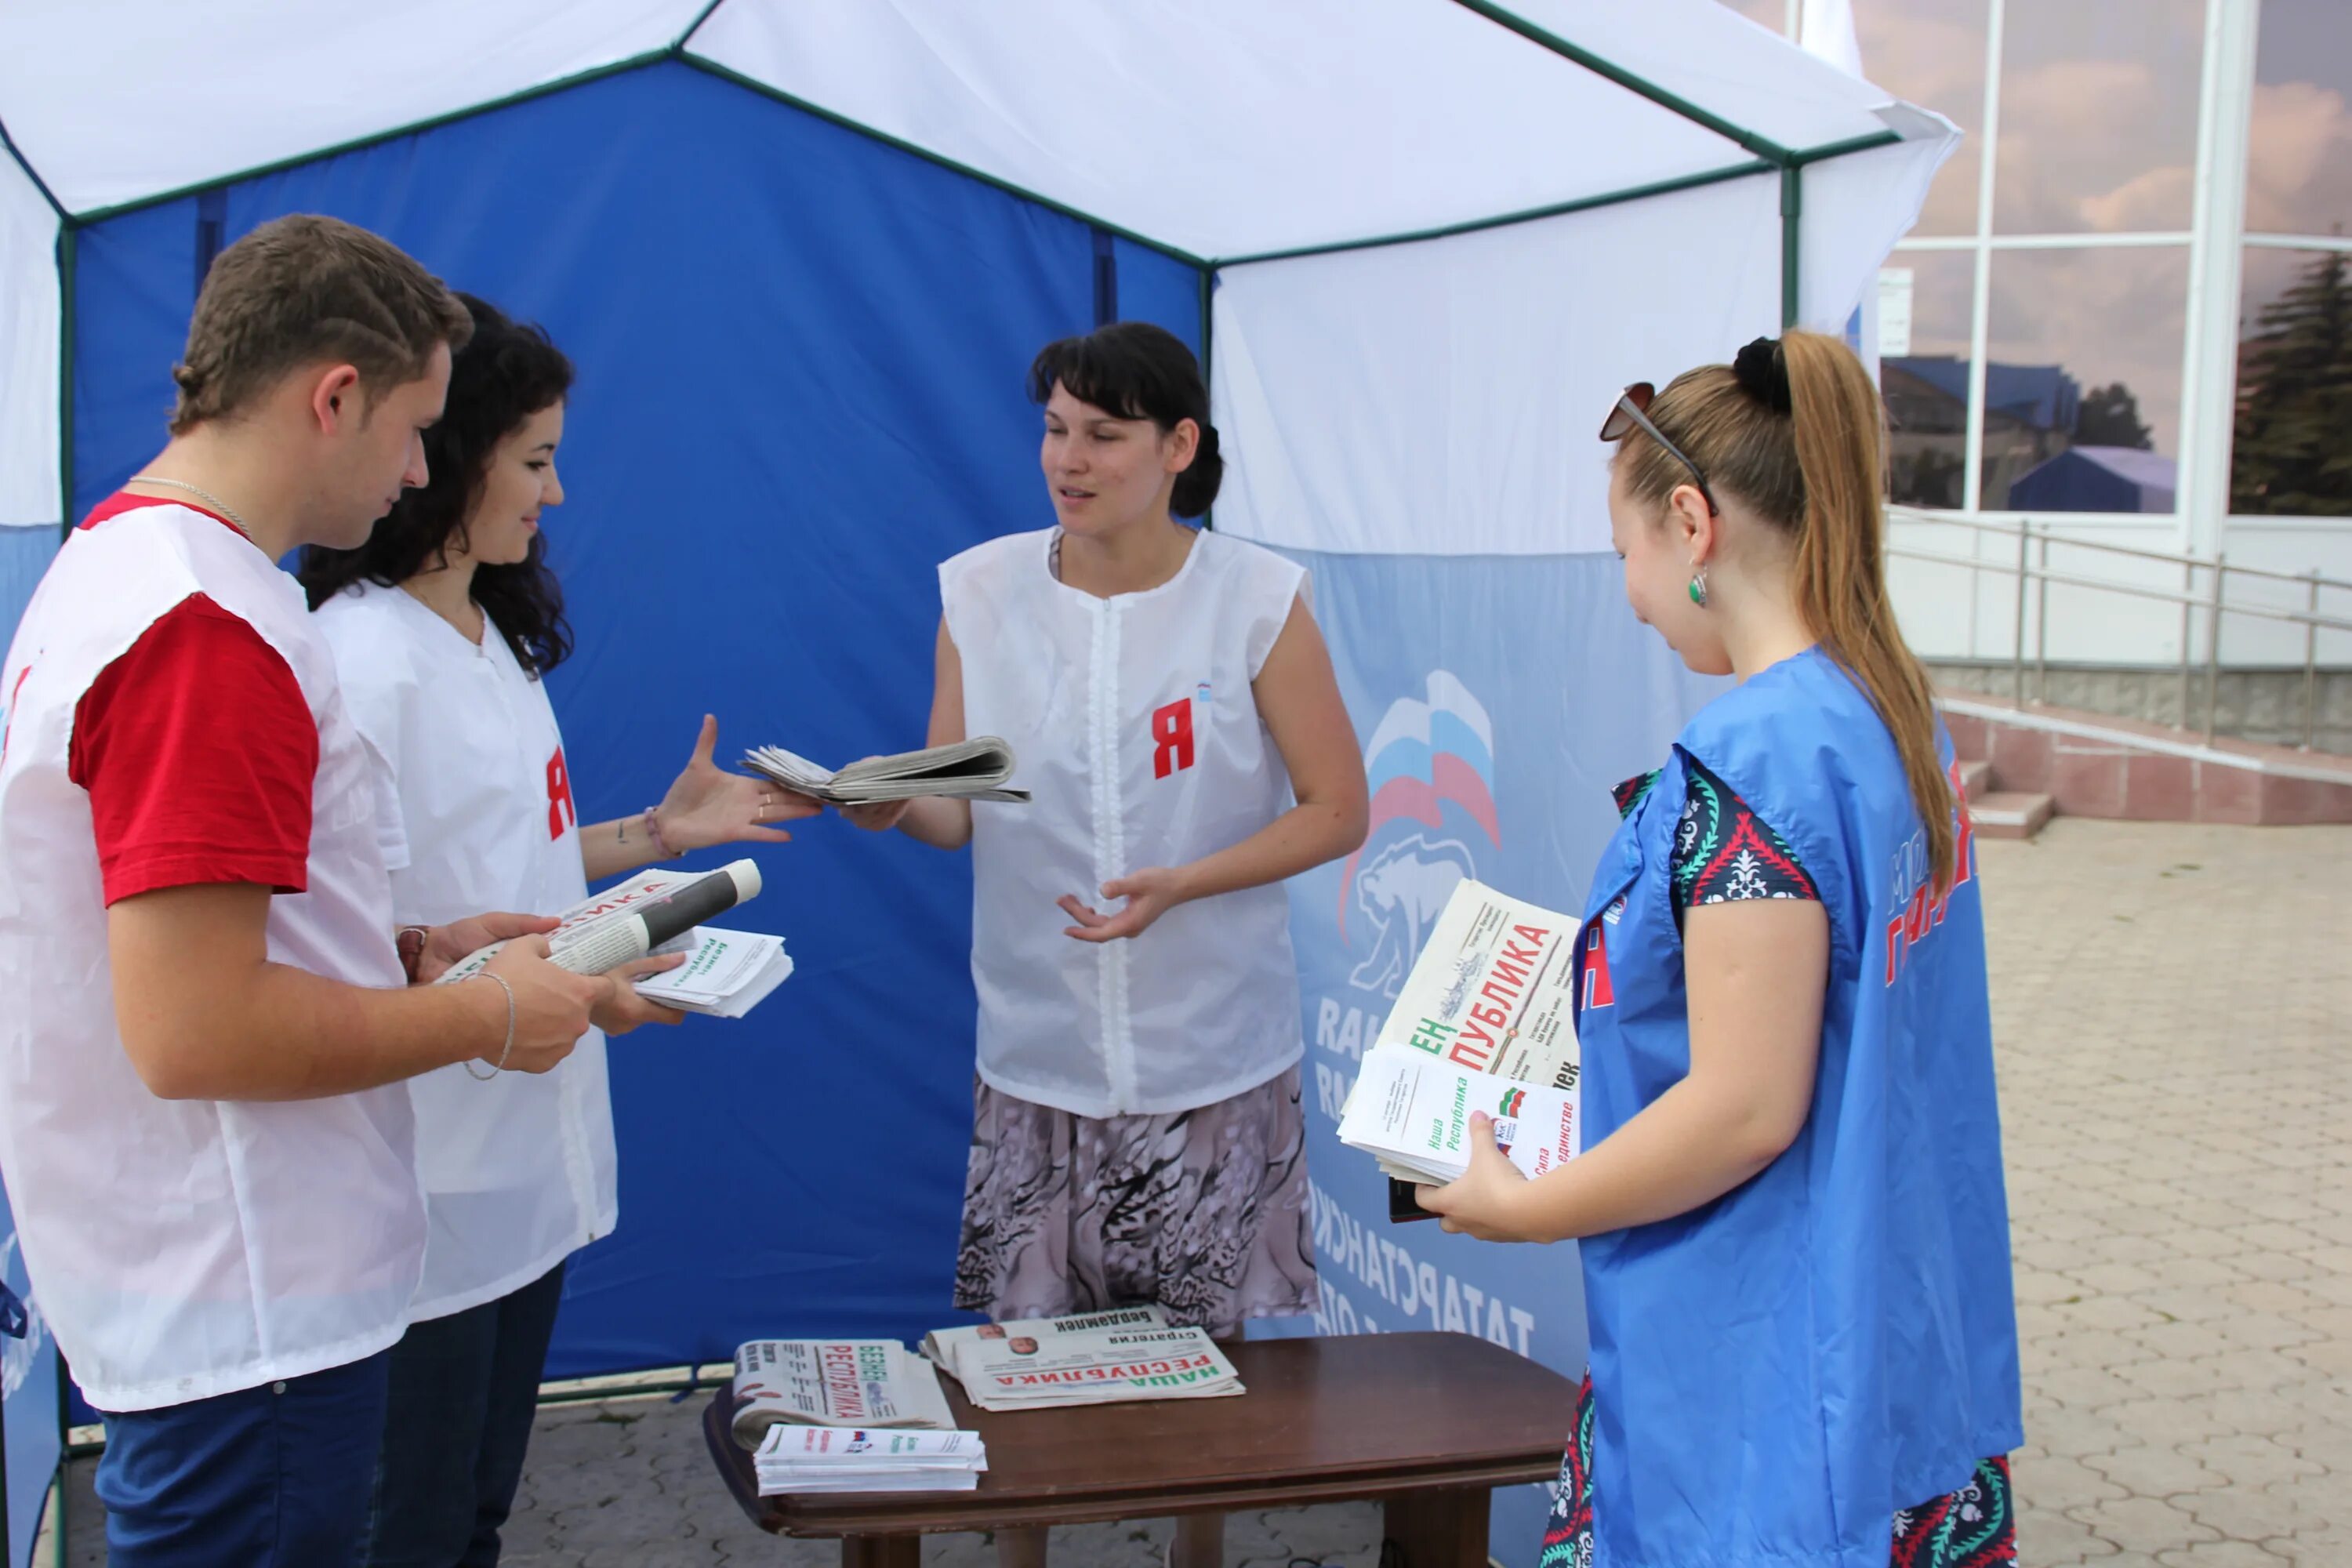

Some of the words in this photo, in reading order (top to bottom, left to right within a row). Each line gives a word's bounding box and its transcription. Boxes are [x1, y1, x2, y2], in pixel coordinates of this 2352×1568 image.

[1152, 697, 1195, 780] Я
[546, 744, 575, 841] Я
[1427, 1118, 1444, 1151] Наша
[1446, 1076, 1468, 1152] Республика
[1557, 1102, 1573, 1163] единстве
[1534, 1147, 1550, 1176] Сила
[1109, 1330, 1198, 1345] Стратегия
[825, 1345, 866, 1419] РЕСПУБЛИКА
[996, 1354, 1214, 1386] РЕСПУБЛИКА
[1128, 1365, 1221, 1388] НАША
